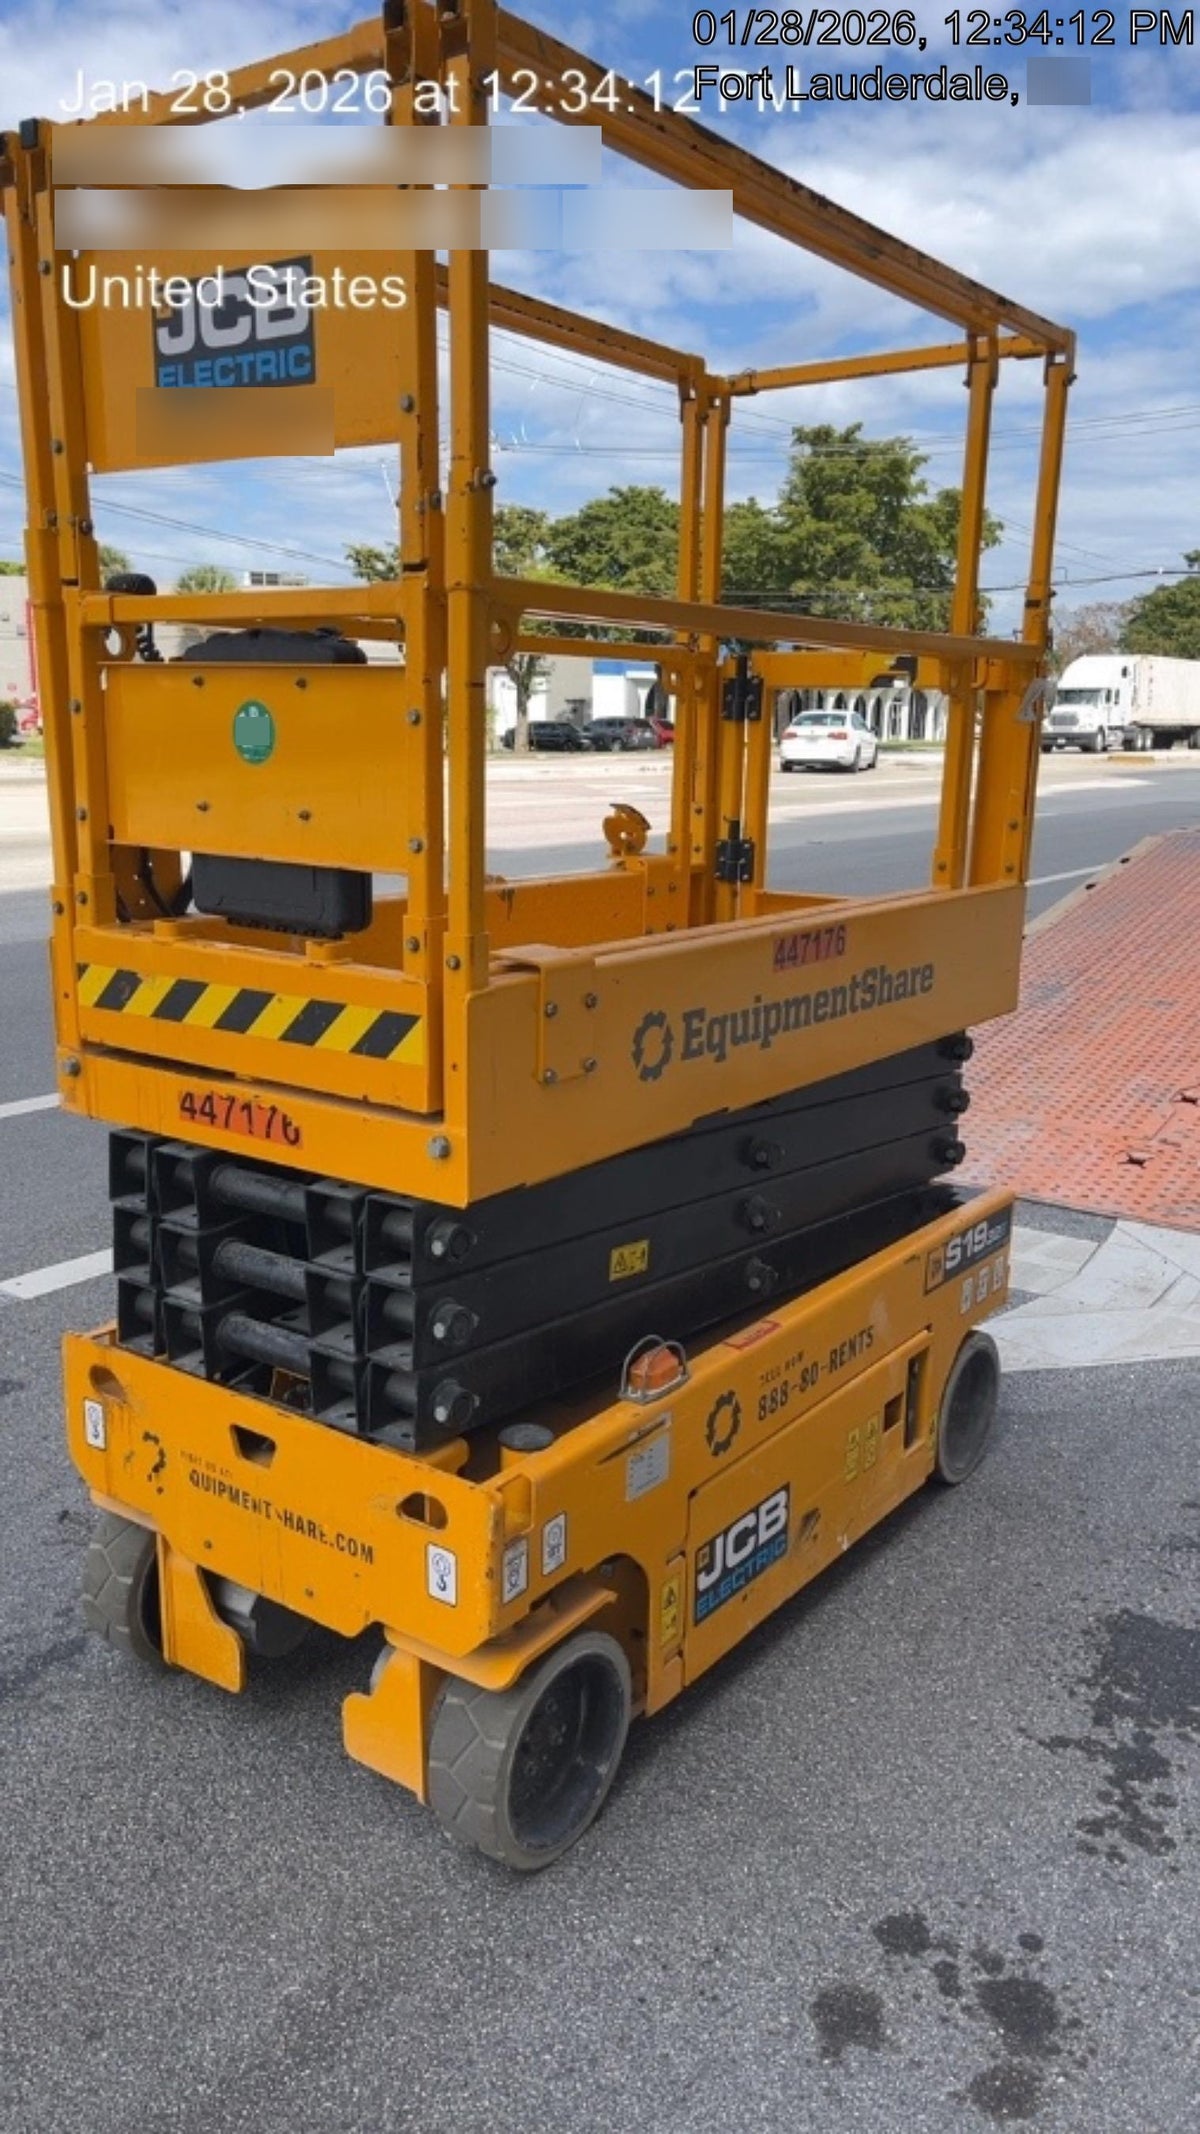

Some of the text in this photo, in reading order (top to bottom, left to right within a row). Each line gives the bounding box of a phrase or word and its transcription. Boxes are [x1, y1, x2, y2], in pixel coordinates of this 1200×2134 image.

[155, 264, 311, 356] JCB
[157, 344, 312, 389] ELECTRIC
[772, 923, 848, 971] 447176
[680, 962, 935, 1063] EquipmentShare
[695, 1488, 789, 1593] JCB
[696, 1531, 788, 1621] ELECTRIC
